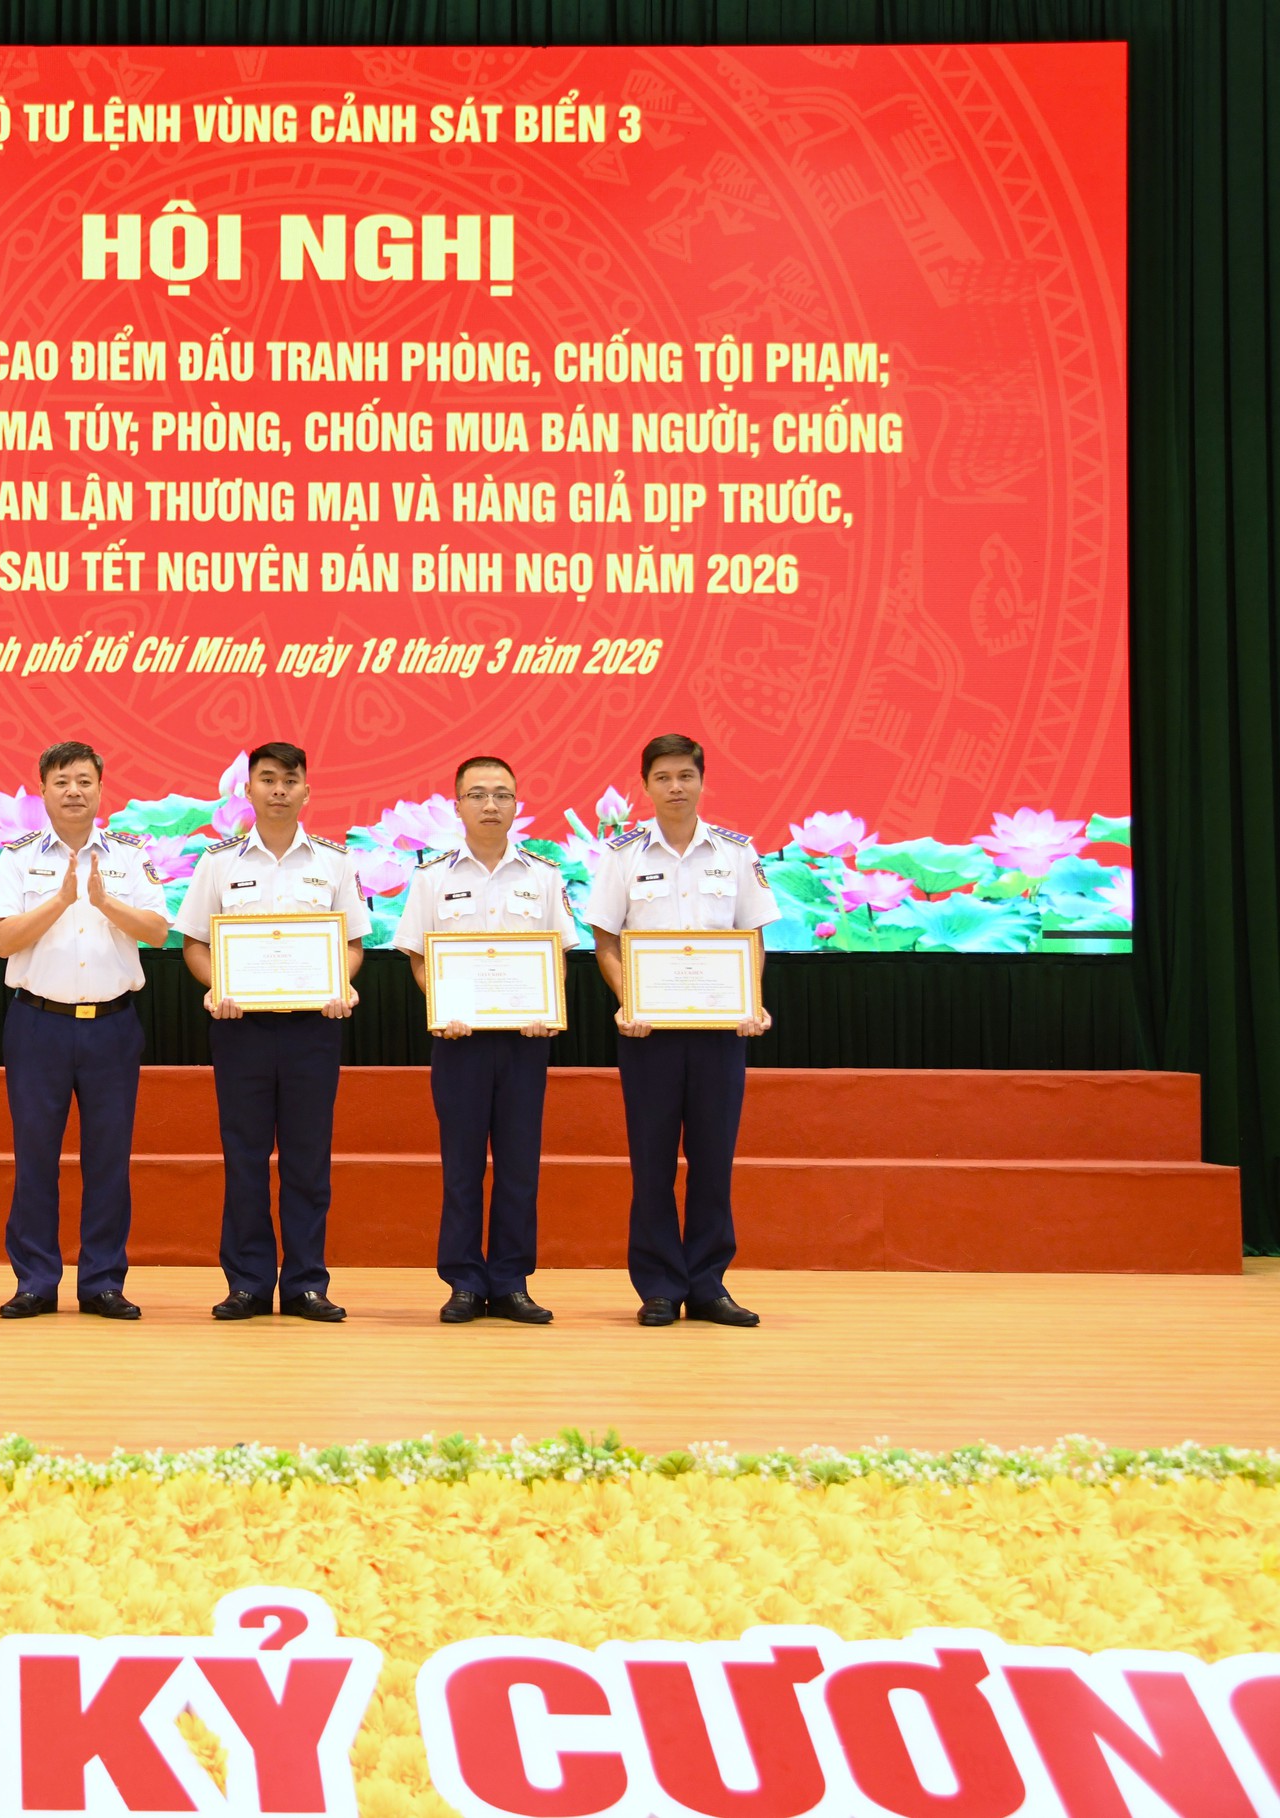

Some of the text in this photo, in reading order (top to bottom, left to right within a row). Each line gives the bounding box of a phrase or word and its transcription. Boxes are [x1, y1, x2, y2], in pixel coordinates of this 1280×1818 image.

[23, 100, 75, 143] TƯ
[83, 96, 181, 151] LỆNH
[193, 96, 298, 143] VÙNG
[310, 91, 417, 143] CẢNH
[429, 96, 503, 144] SÁT
[515, 89, 606, 143] BIỂN
[618, 104, 642, 144] 3
[81, 199, 515, 297] HỘI NGHỊ
[70, 324, 167, 381] ĐIỂM
[177, 327, 254, 382] ĐẤU
[266, 341, 389, 382] TRANH
[401, 332, 541, 388] PHÒNG,
[554, 327, 683, 383] CHỐNG
[694, 333, 753, 392] TỘI
[766, 342, 890, 392] PHẠM;
[64, 402, 139, 457] TÚY;
[152, 401, 292, 457] PHÒNG,
[304, 397, 433, 453] CHỐNG
[446, 412, 530, 453] MUA
[541, 403, 620, 453] BÁN
[632, 402, 760, 459] NGƯỜI;
[772, 398, 903, 454] CHỐNG
[60, 472, 133, 531] LẬN
[144, 477, 295, 522] THƯƠNG
[307, 481, 380, 531] MẠI
[391, 473, 441, 522] VÀ
[452, 473, 556, 523] HÀNG
[568, 469, 633, 523] GIẢ
[643, 482, 707, 532] DỊP
[718, 474, 853, 529] TRƯỚC,
[81, 538, 146, 592] TẾT
[157, 543, 309, 593] NGUYÊN
[320, 543, 399, 593] ĐÁN
[412, 543, 503, 593] BÍNH
[515, 552, 594, 603] NGỌ
[606, 544, 695, 594] NĂM
[706, 553, 799, 595] 2026
[20, 630, 93, 677] phố
[84, 630, 135, 673] Hồ
[132, 635, 190, 673] Chí
[185, 636, 268, 678] Minh,
[275, 636, 354, 679] ngày
[357, 637, 398, 674] 18
[397, 636, 486, 679] tháng
[486, 637, 513, 674] 3
[511, 636, 582, 675] năm
[582, 637, 664, 675] 2026
[19, 1604, 353, 1814] KỶ
[445, 1645, 1280, 1818] CƯƠN
